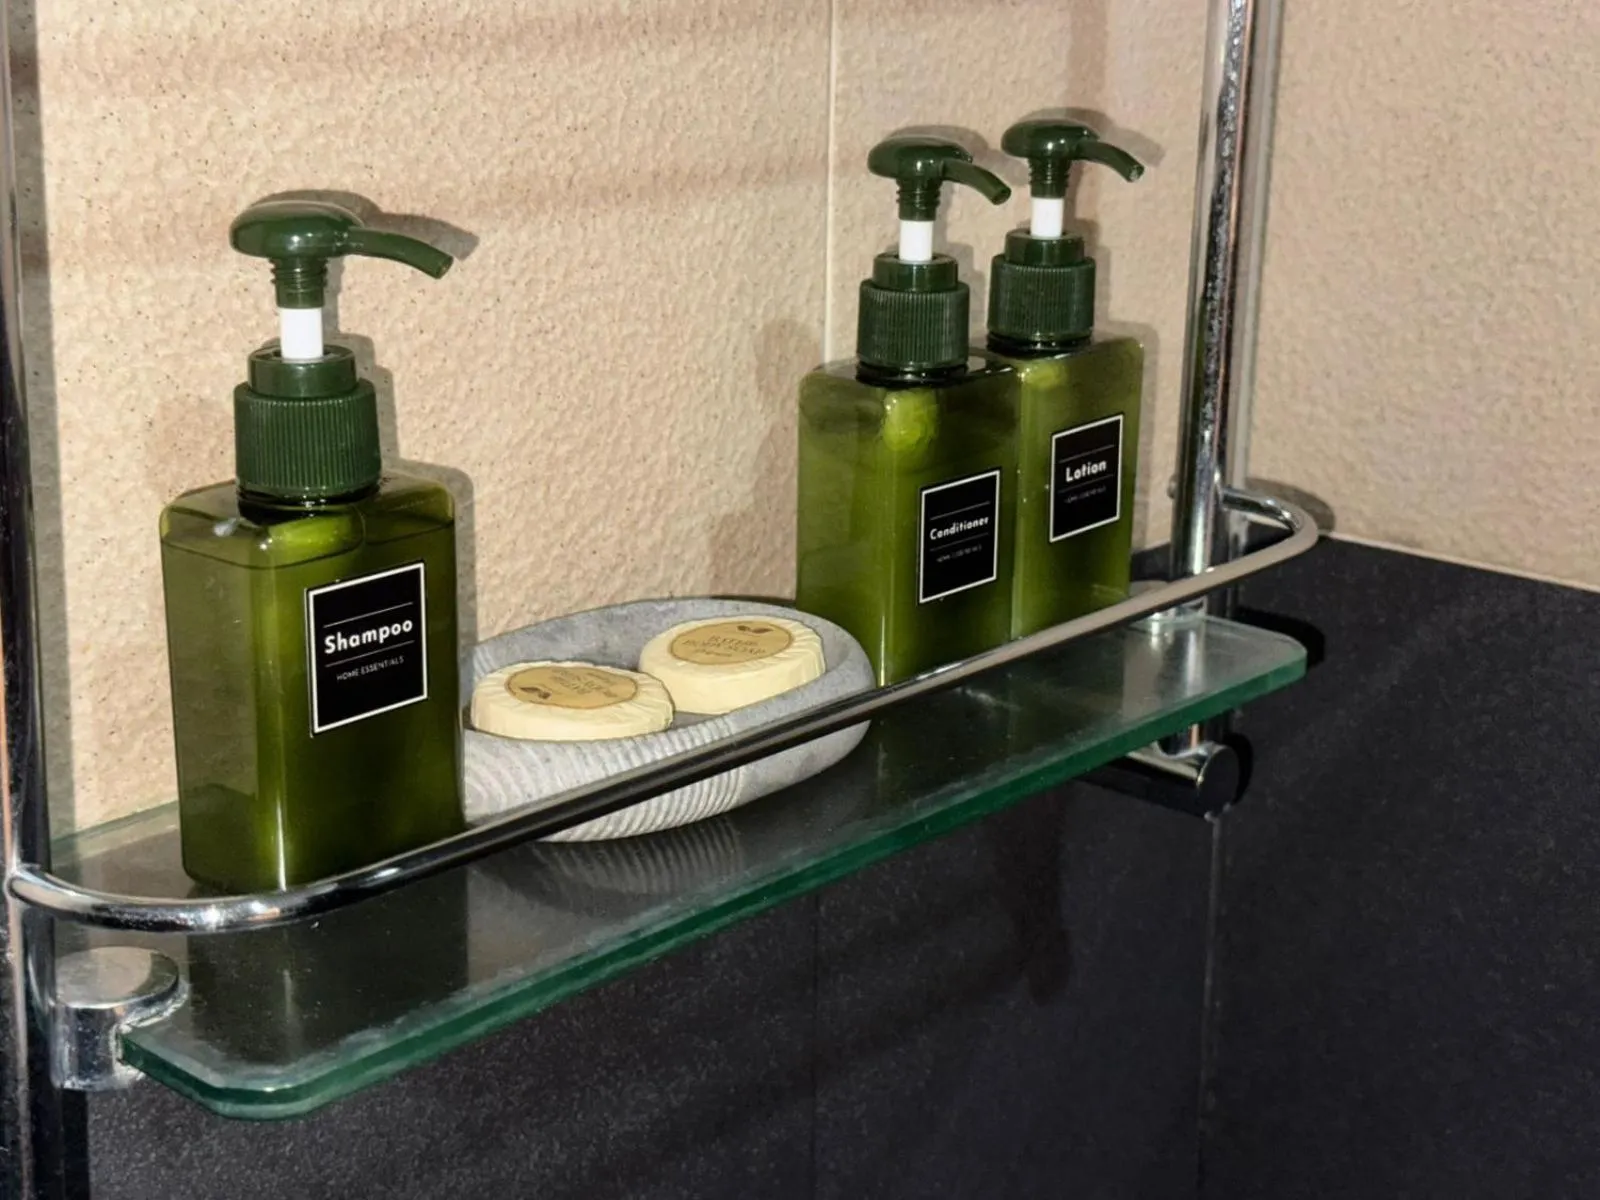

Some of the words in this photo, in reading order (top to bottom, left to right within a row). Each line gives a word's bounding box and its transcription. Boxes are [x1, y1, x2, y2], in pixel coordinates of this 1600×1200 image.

[1065, 460, 1107, 482] Lotion
[929, 517, 989, 540] Conditioner
[324, 620, 413, 654] Shampoo
[336, 668, 359, 681] HOME
[360, 655, 404, 675] ESSENTIALS
